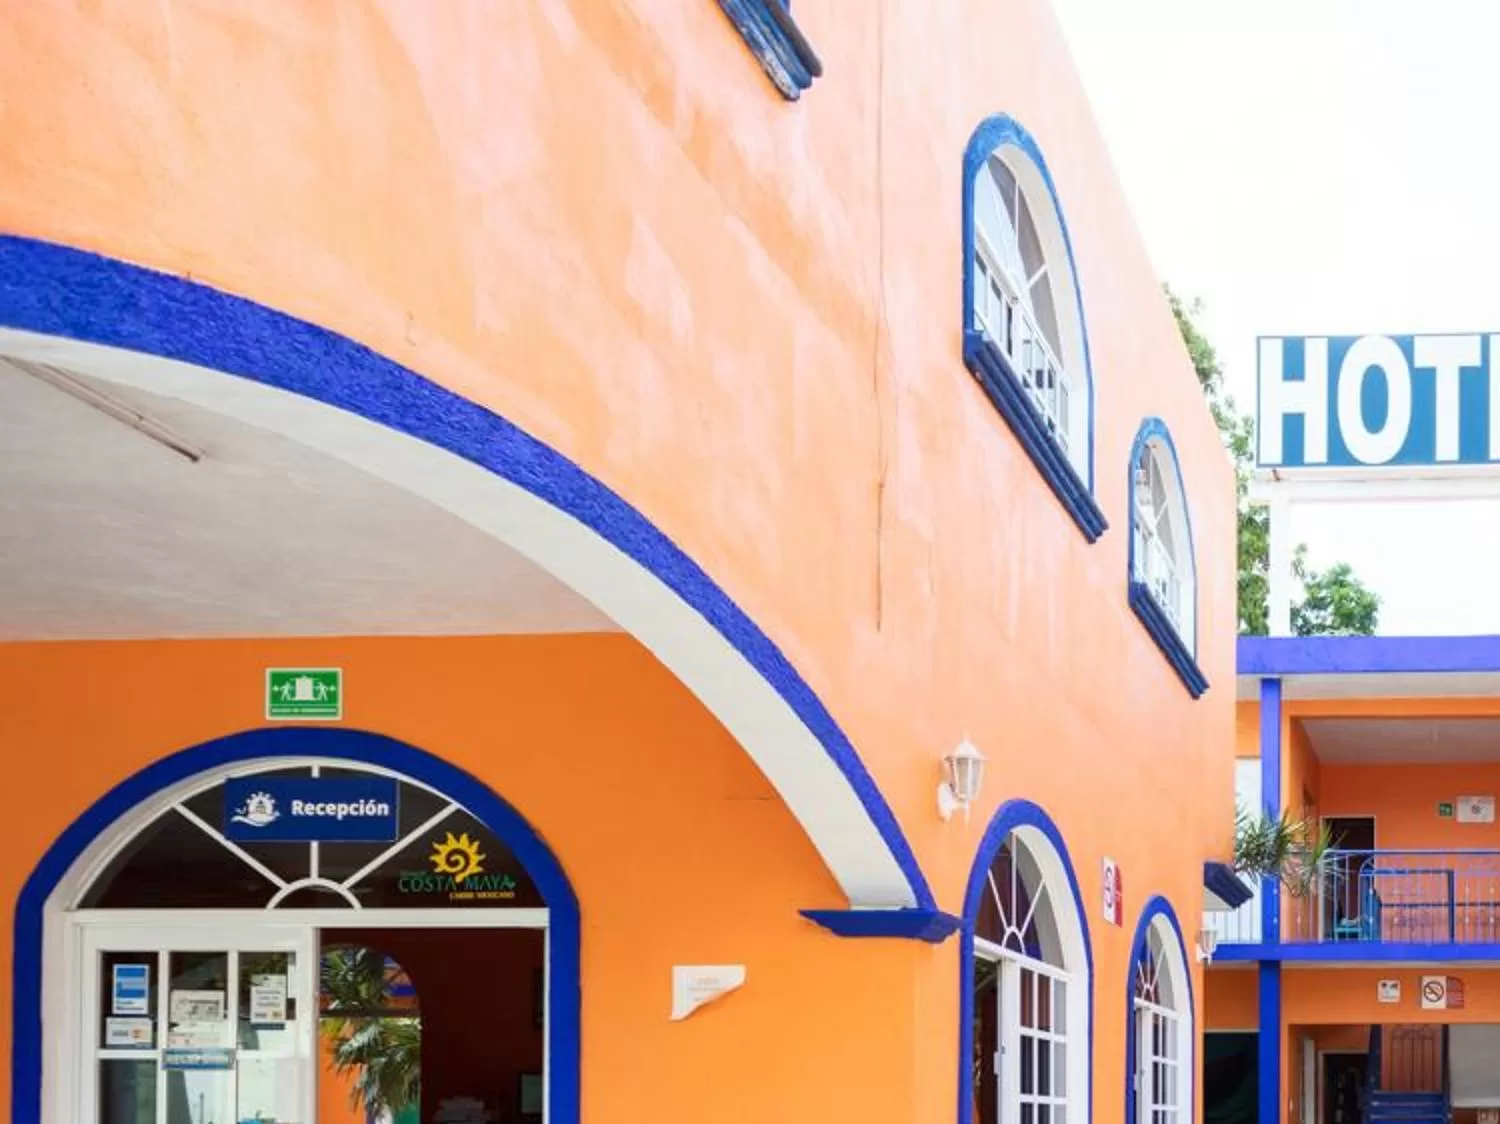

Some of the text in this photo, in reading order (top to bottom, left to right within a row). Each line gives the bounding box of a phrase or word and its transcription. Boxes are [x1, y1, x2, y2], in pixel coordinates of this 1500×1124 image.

[291, 798, 389, 821] Recepción
[399, 874, 512, 893] COSTA MAYA
